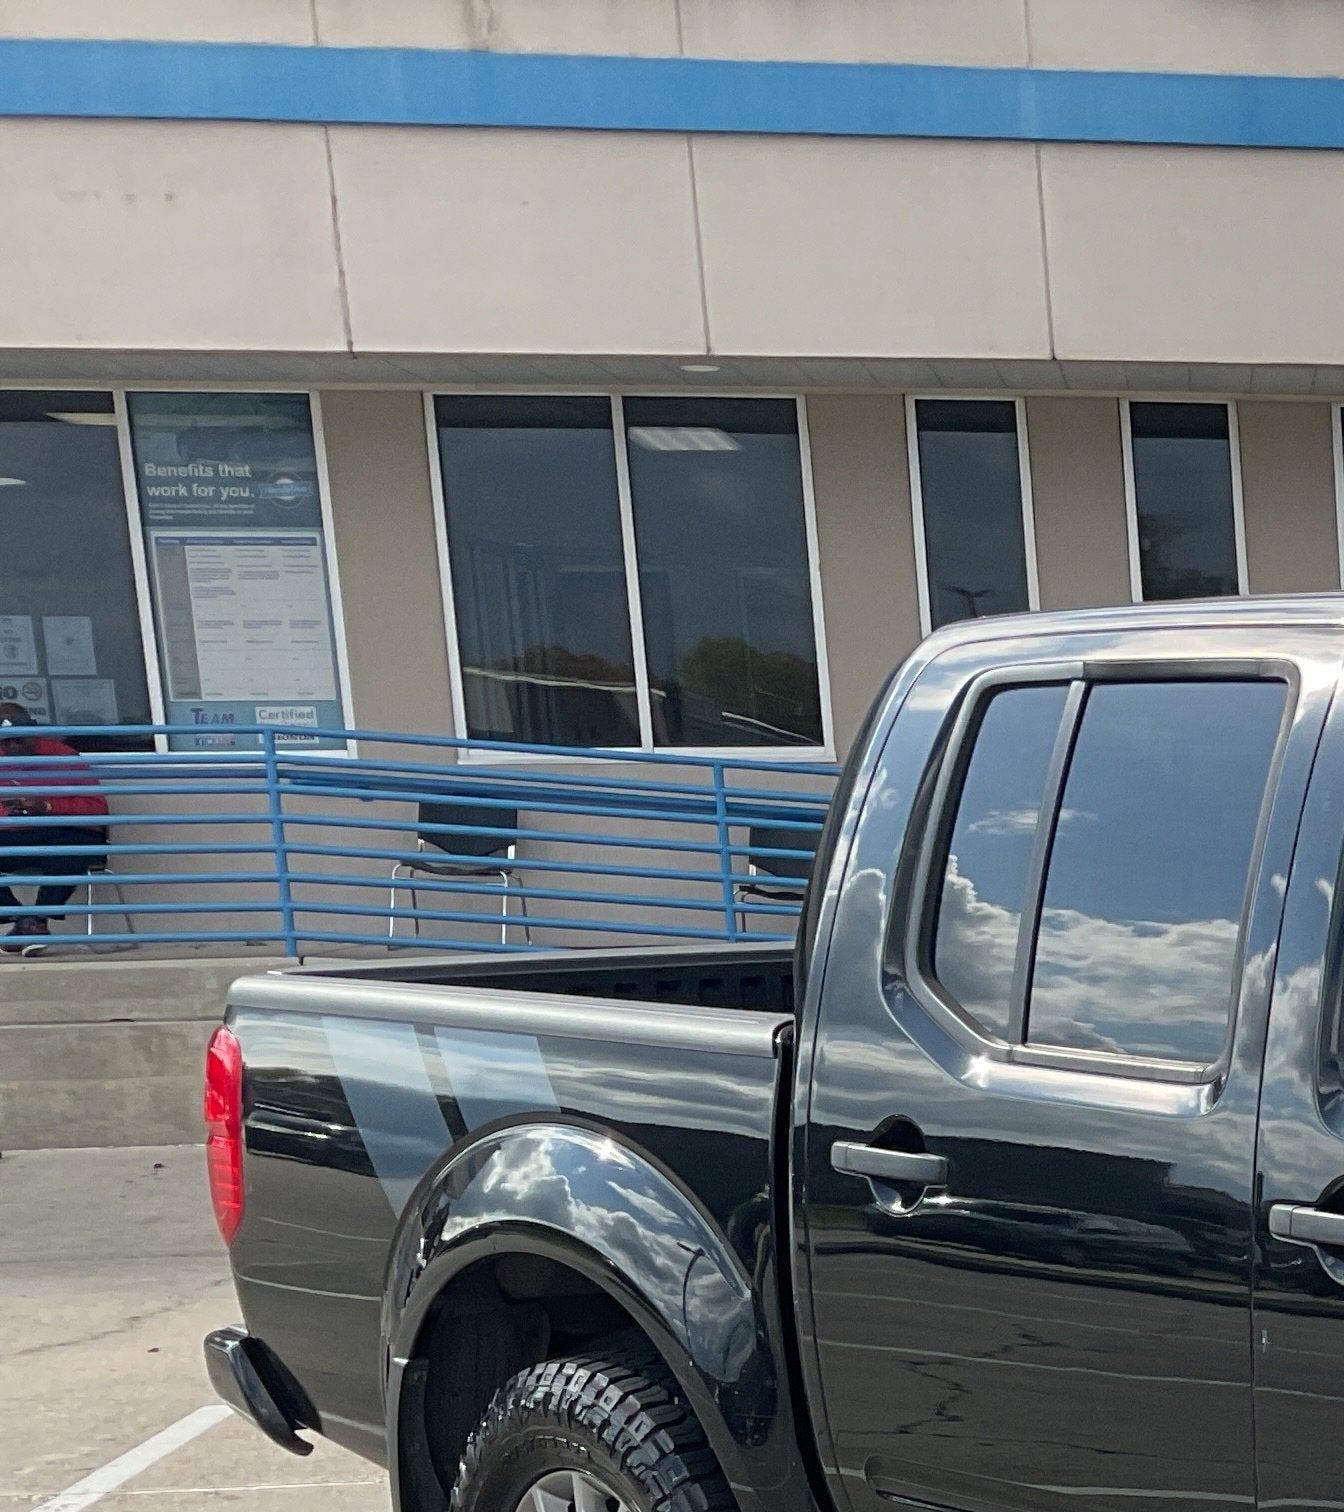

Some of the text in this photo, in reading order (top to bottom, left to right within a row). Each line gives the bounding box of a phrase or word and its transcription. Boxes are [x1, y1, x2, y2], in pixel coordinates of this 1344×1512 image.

[144, 463, 252, 478] Benefits that
[147, 483, 188, 497] work
[192, 483, 216, 497] for
[219, 485, 255, 500] you.
[258, 709, 315, 720] Certified
